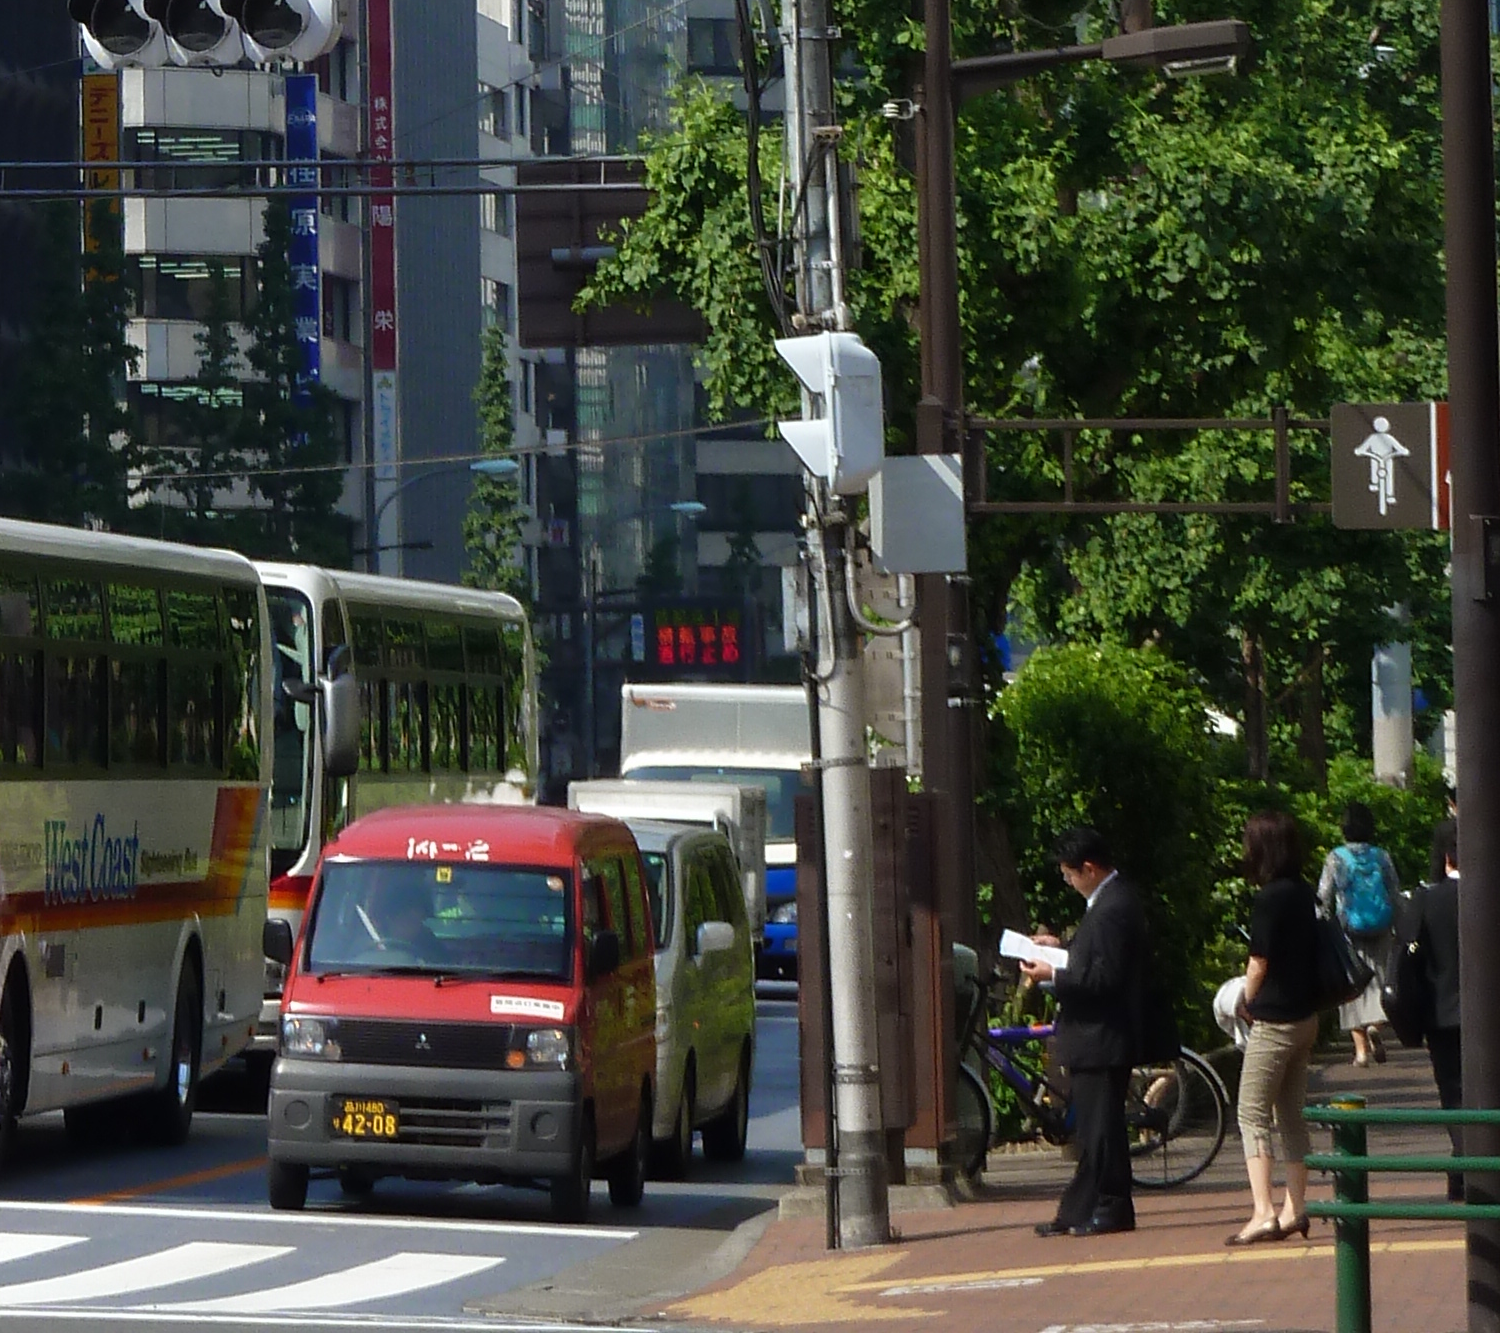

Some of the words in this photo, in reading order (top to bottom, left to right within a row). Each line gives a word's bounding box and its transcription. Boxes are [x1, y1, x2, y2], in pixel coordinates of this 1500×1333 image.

[658, 645, 739, 665] 通行止め
[44, 819, 88, 906] West
[90, 812, 139, 902] Coast
[343, 1115, 395, 1136] 42-08
